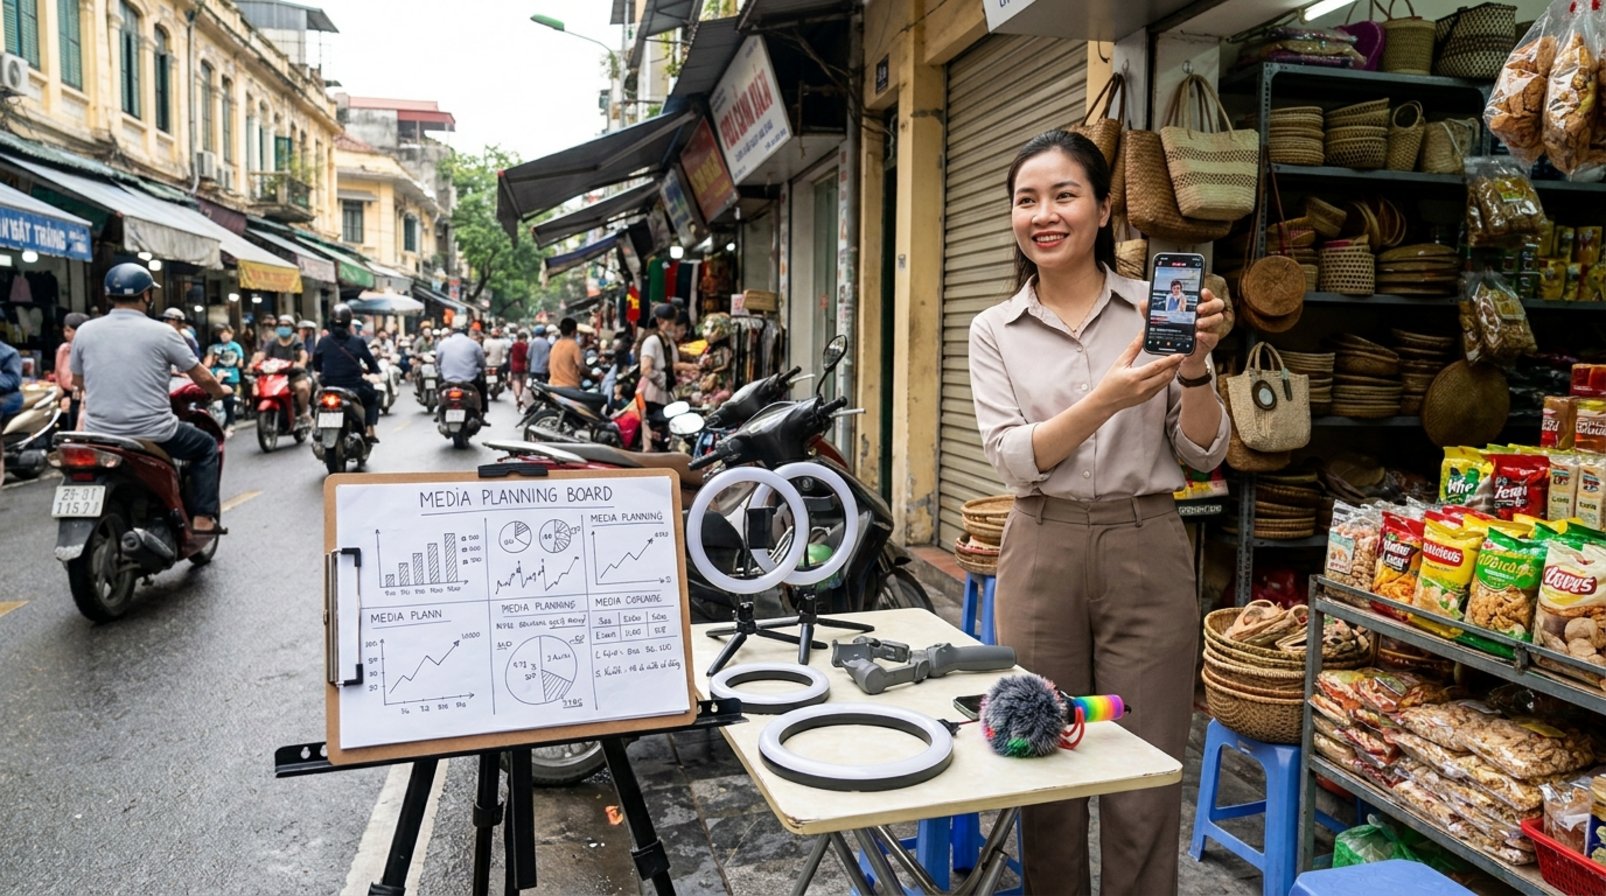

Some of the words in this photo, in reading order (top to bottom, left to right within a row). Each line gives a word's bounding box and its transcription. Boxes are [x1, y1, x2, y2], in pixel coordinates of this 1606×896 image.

[481, 487, 558, 506] PLANNING
[567, 486, 613, 503] BOARD
[590, 513, 617, 523] MEDIA
[621, 511, 663, 522] PLANNING
[595, 596, 621, 607] MEDIA
[501, 603, 530, 614] MEDIA
[370, 612, 404, 623] MEDIA
[410, 609, 442, 620] PLANN
